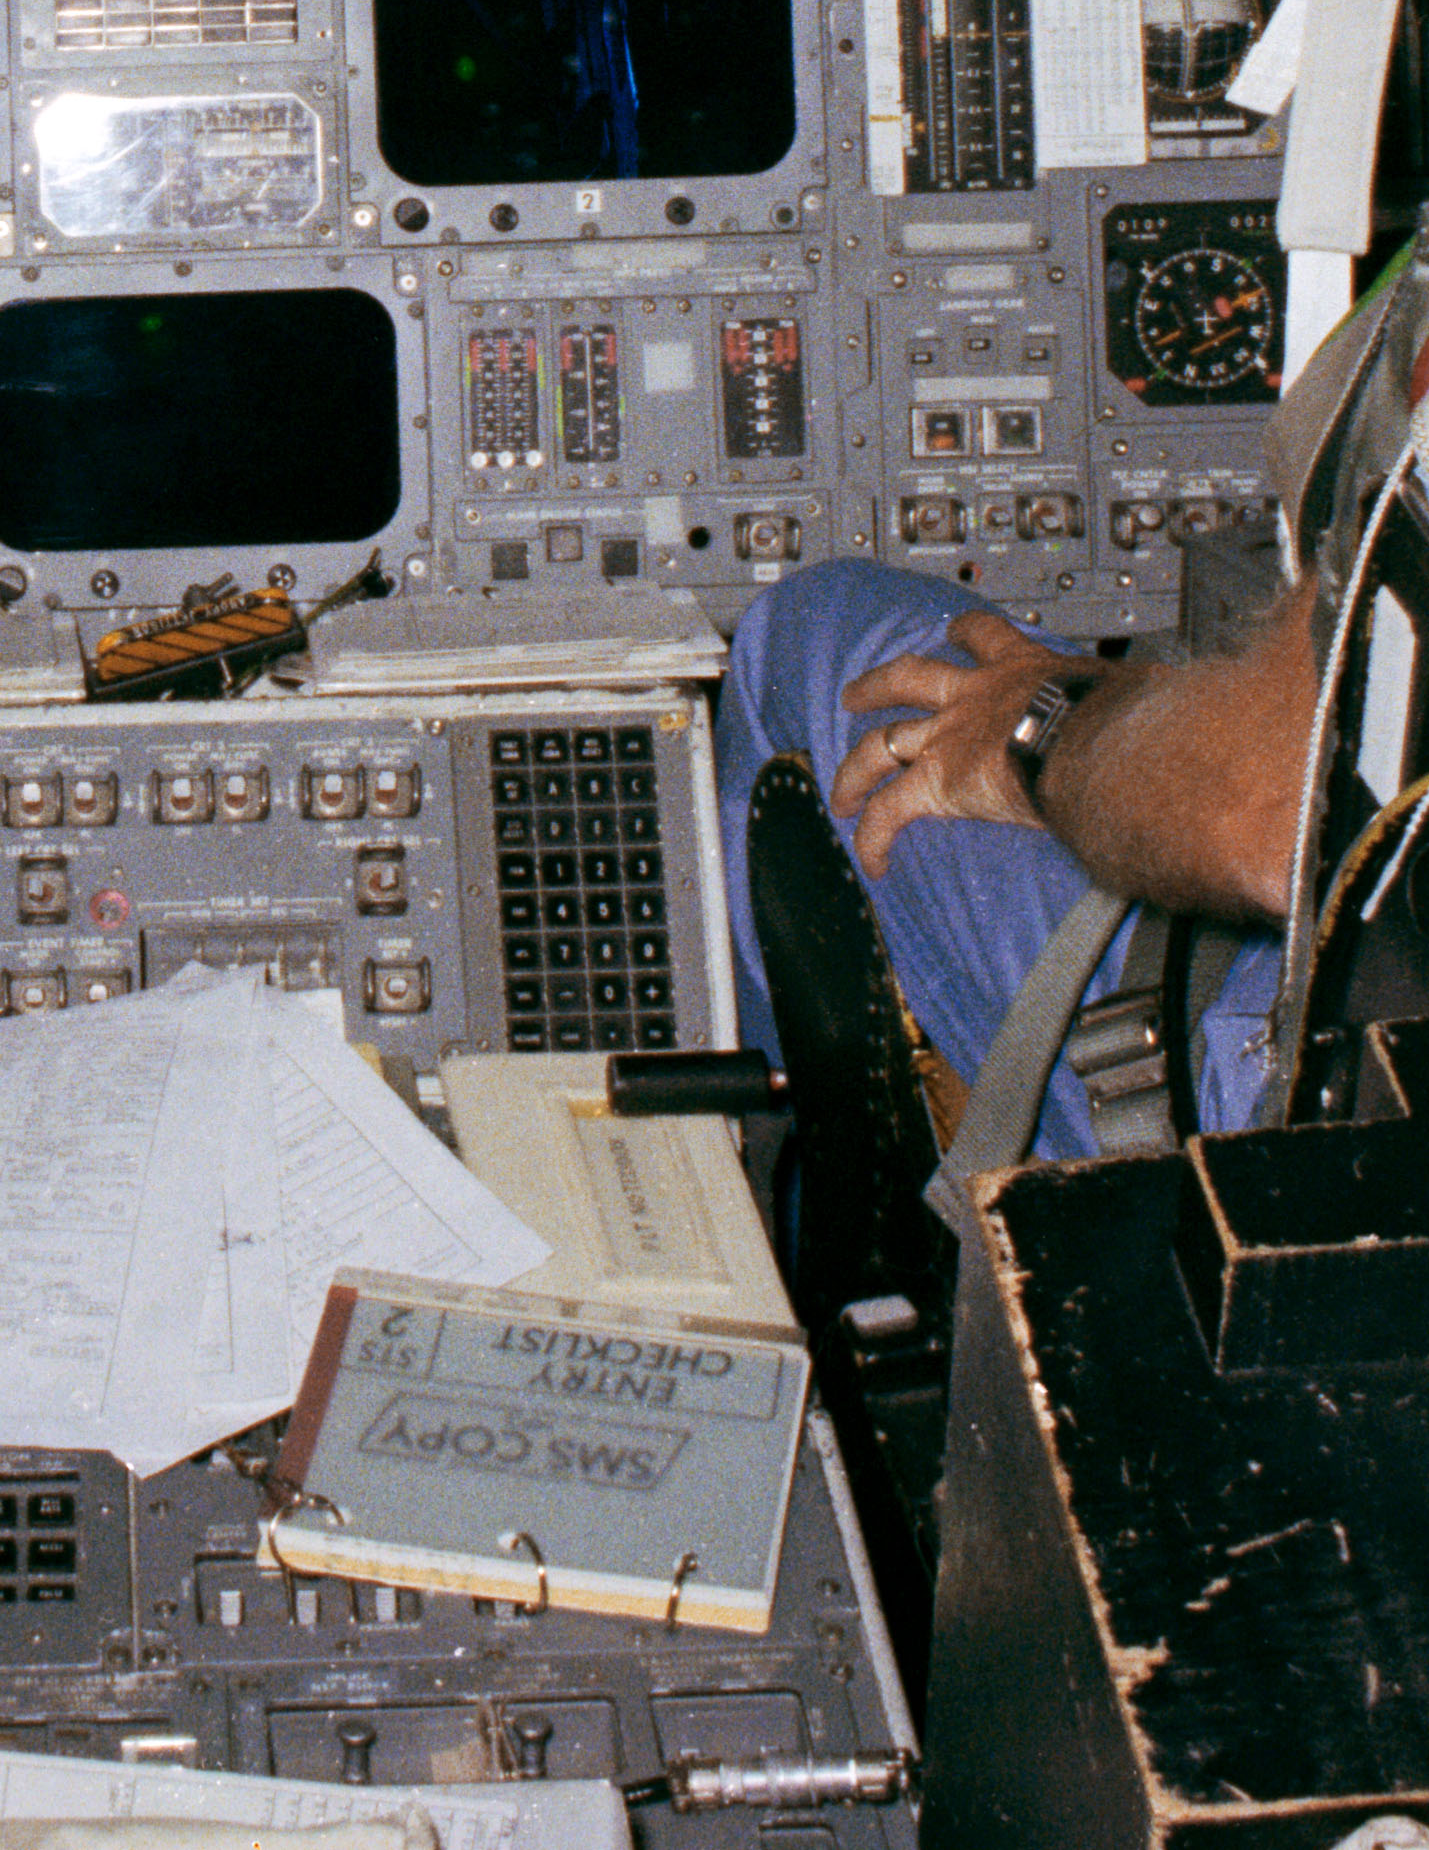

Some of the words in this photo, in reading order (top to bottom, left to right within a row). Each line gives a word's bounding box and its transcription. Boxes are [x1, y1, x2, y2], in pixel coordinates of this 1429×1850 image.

[582, 194, 594, 209] 2
[1211, 258, 1221, 272] S
[940, 301, 990, 311] LANDING
[996, 299, 1024, 308] GEAR
[1184, 364, 1197, 377] N
[982, 464, 1017, 473] SELECT
[549, 782, 557, 794] A
[556, 863, 563, 877] 1
[596, 862, 605, 877] 2
[639, 860, 648, 876] 3
[210, 897, 246, 907] TIMER
[250, 896, 270, 906] SET
[557, 904, 567, 918] 4
[599, 903, 608, 917] 5
[642, 903, 651, 917] 6
[27, 938, 66, 949] EVENT
[70, 938, 104, 948] TIMER
[378, 938, 413, 949] TIMER
[560, 944, 569, 960] 7
[602, 944, 611, 959] 8
[605, 986, 614, 1000] 0
[381, 1305, 414, 1337] 2
[358, 1339, 417, 1369] STS
[490, 1324, 733, 1377] CHECKLIST
[526, 1365, 678, 1404] ENTRY
[379, 1414, 532, 1463] COPY
[547, 1437, 655, 1480] SMS
